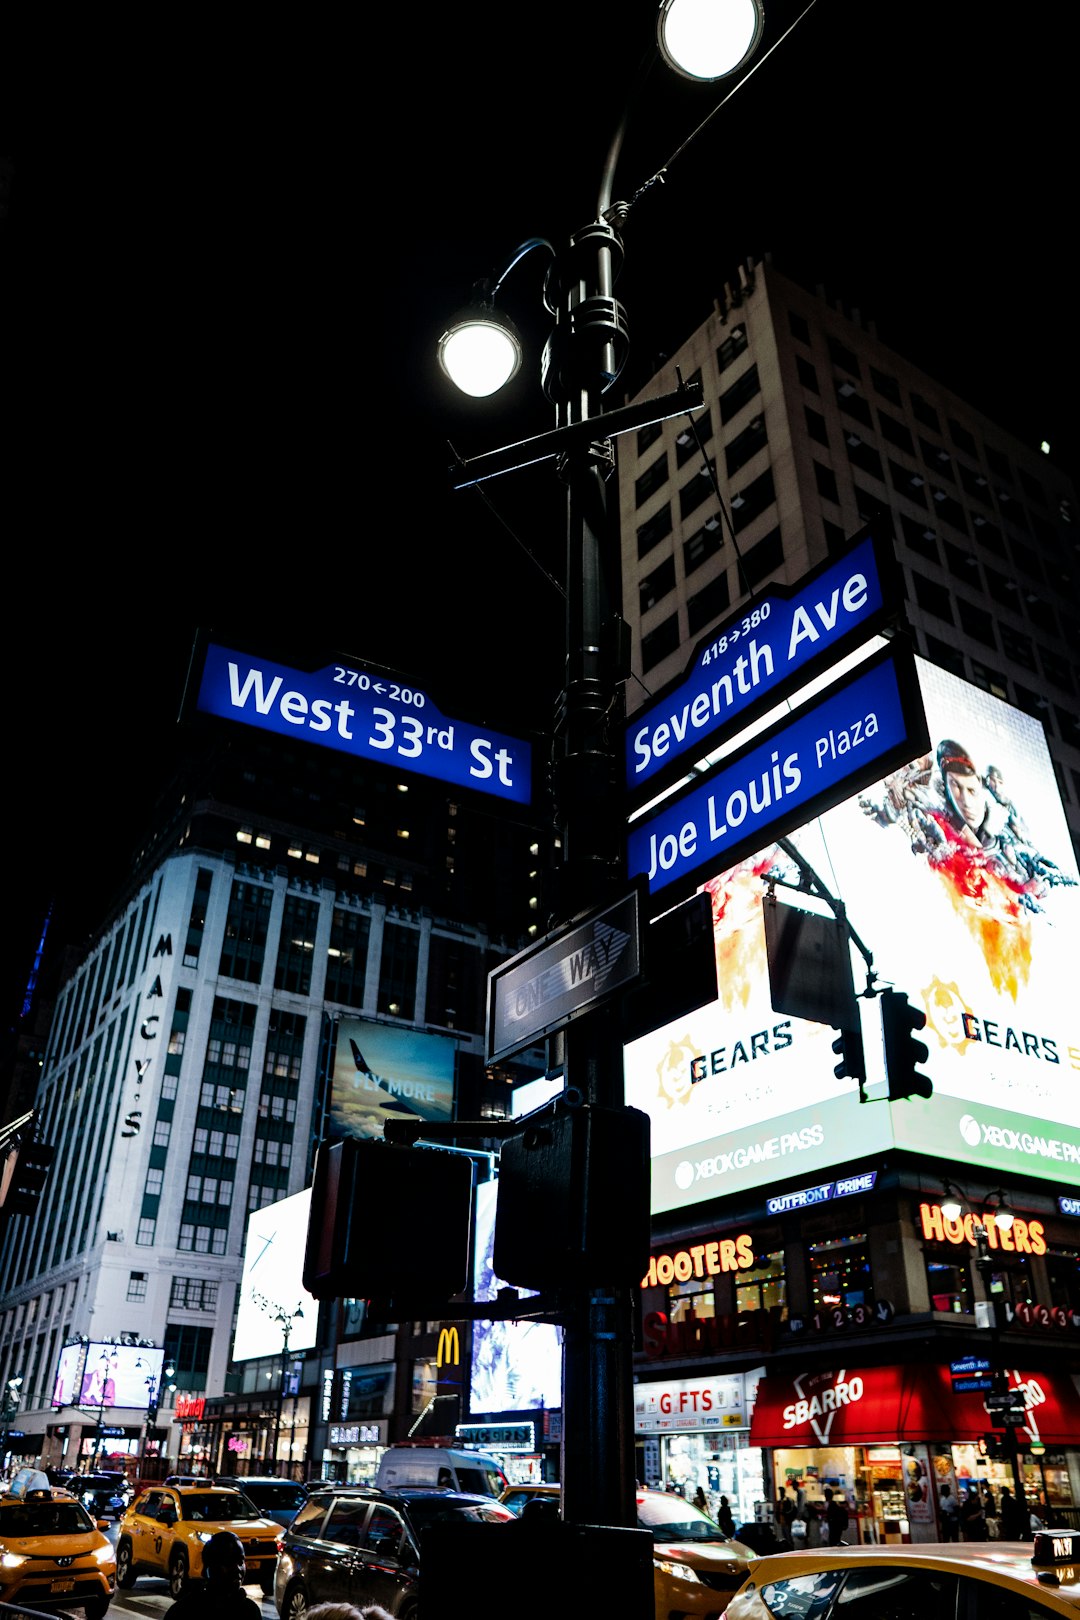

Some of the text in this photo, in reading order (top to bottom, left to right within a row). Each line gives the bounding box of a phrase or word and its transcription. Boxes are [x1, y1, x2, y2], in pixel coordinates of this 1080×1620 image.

[702, 602, 771, 666] 418 380
[333, 667, 425, 708] 270 200
[634, 572, 868, 773] Seventh Ave
[228, 662, 513, 786] West 33rd St
[648, 712, 879, 880] Joe Louis Plaza
[569, 931, 615, 985] WAY
[690, 1020, 794, 1085] GEARS
[961, 1013, 1060, 1064] GEARS
[354, 1071, 436, 1102] FLY MORE
[695, 1124, 825, 1181] XBOX GAME PASS
[982, 1124, 1023, 1152] XBOX
[1021, 1133, 1064, 1160] GAME
[769, 1175, 873, 1213] OUTFRONT PRIME
[813, 1307, 865, 1329] 1 2 3
[1022, 1306, 1030, 1323] 1
[1040, 1308, 1050, 1325] 2
[1057, 1311, 1067, 1327] 3
[783, 1377, 864, 1430] SBARRO
[490, 1426, 527, 1441] GIFTS
